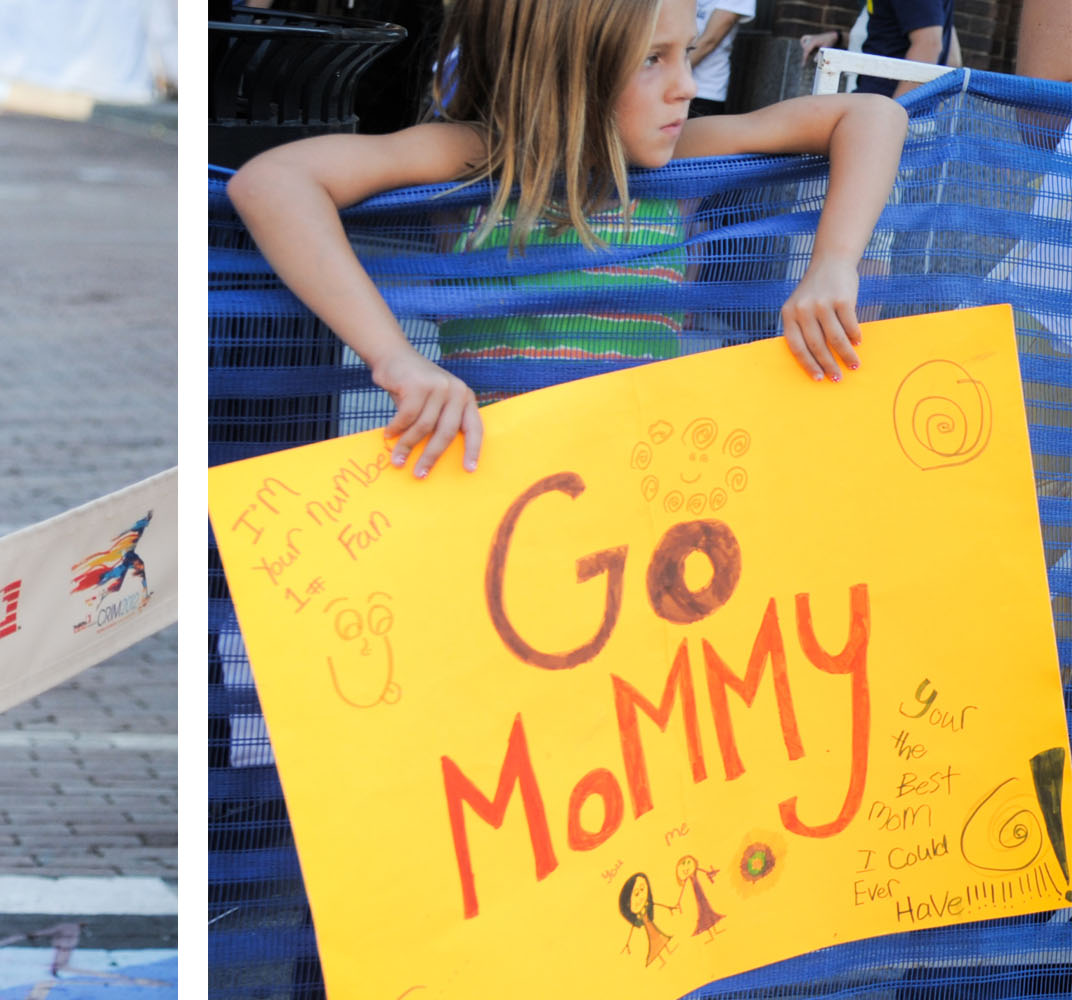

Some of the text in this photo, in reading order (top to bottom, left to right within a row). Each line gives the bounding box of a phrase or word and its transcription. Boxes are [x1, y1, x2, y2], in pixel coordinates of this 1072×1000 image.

[336, 509, 392, 561] Fan
[891, 729, 929, 761] the
[895, 765, 961, 799] Best
[663, 822, 691, 847] me
[855, 834, 950, 874] I Could
[854, 878, 901, 907] Ever
